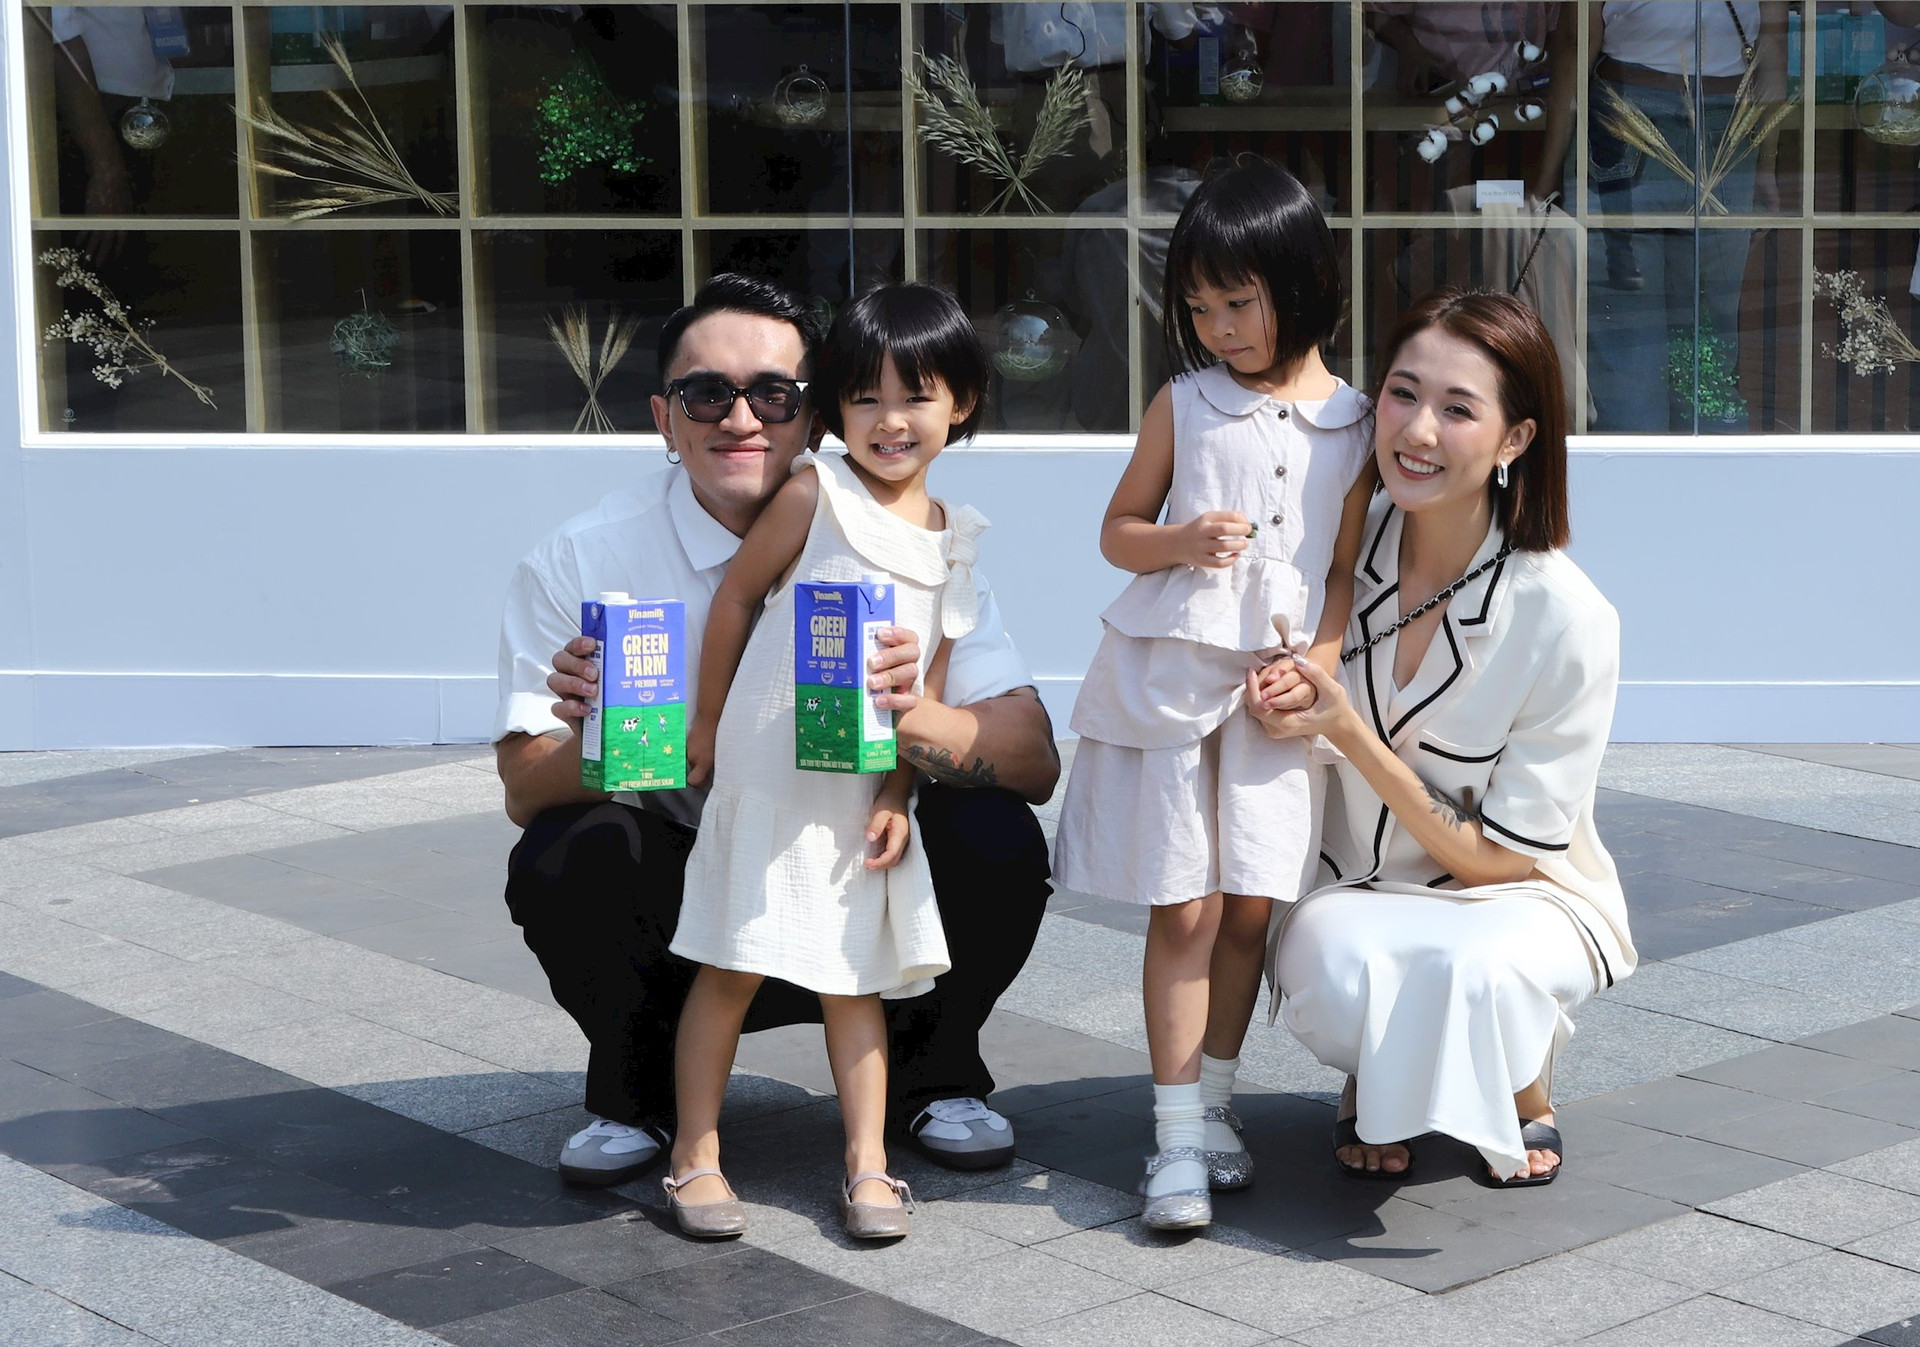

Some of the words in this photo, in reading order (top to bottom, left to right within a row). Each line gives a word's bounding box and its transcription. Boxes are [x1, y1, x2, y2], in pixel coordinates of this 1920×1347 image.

[813, 590, 843, 601] Vinamilk
[628, 608, 665, 620] Vinamilk
[810, 615, 847, 637] GREEN
[622, 633, 669, 656] GREEN
[812, 636, 845, 658] FARM
[625, 655, 667, 677] FARM
[635, 679, 657, 688] PREMIUM
